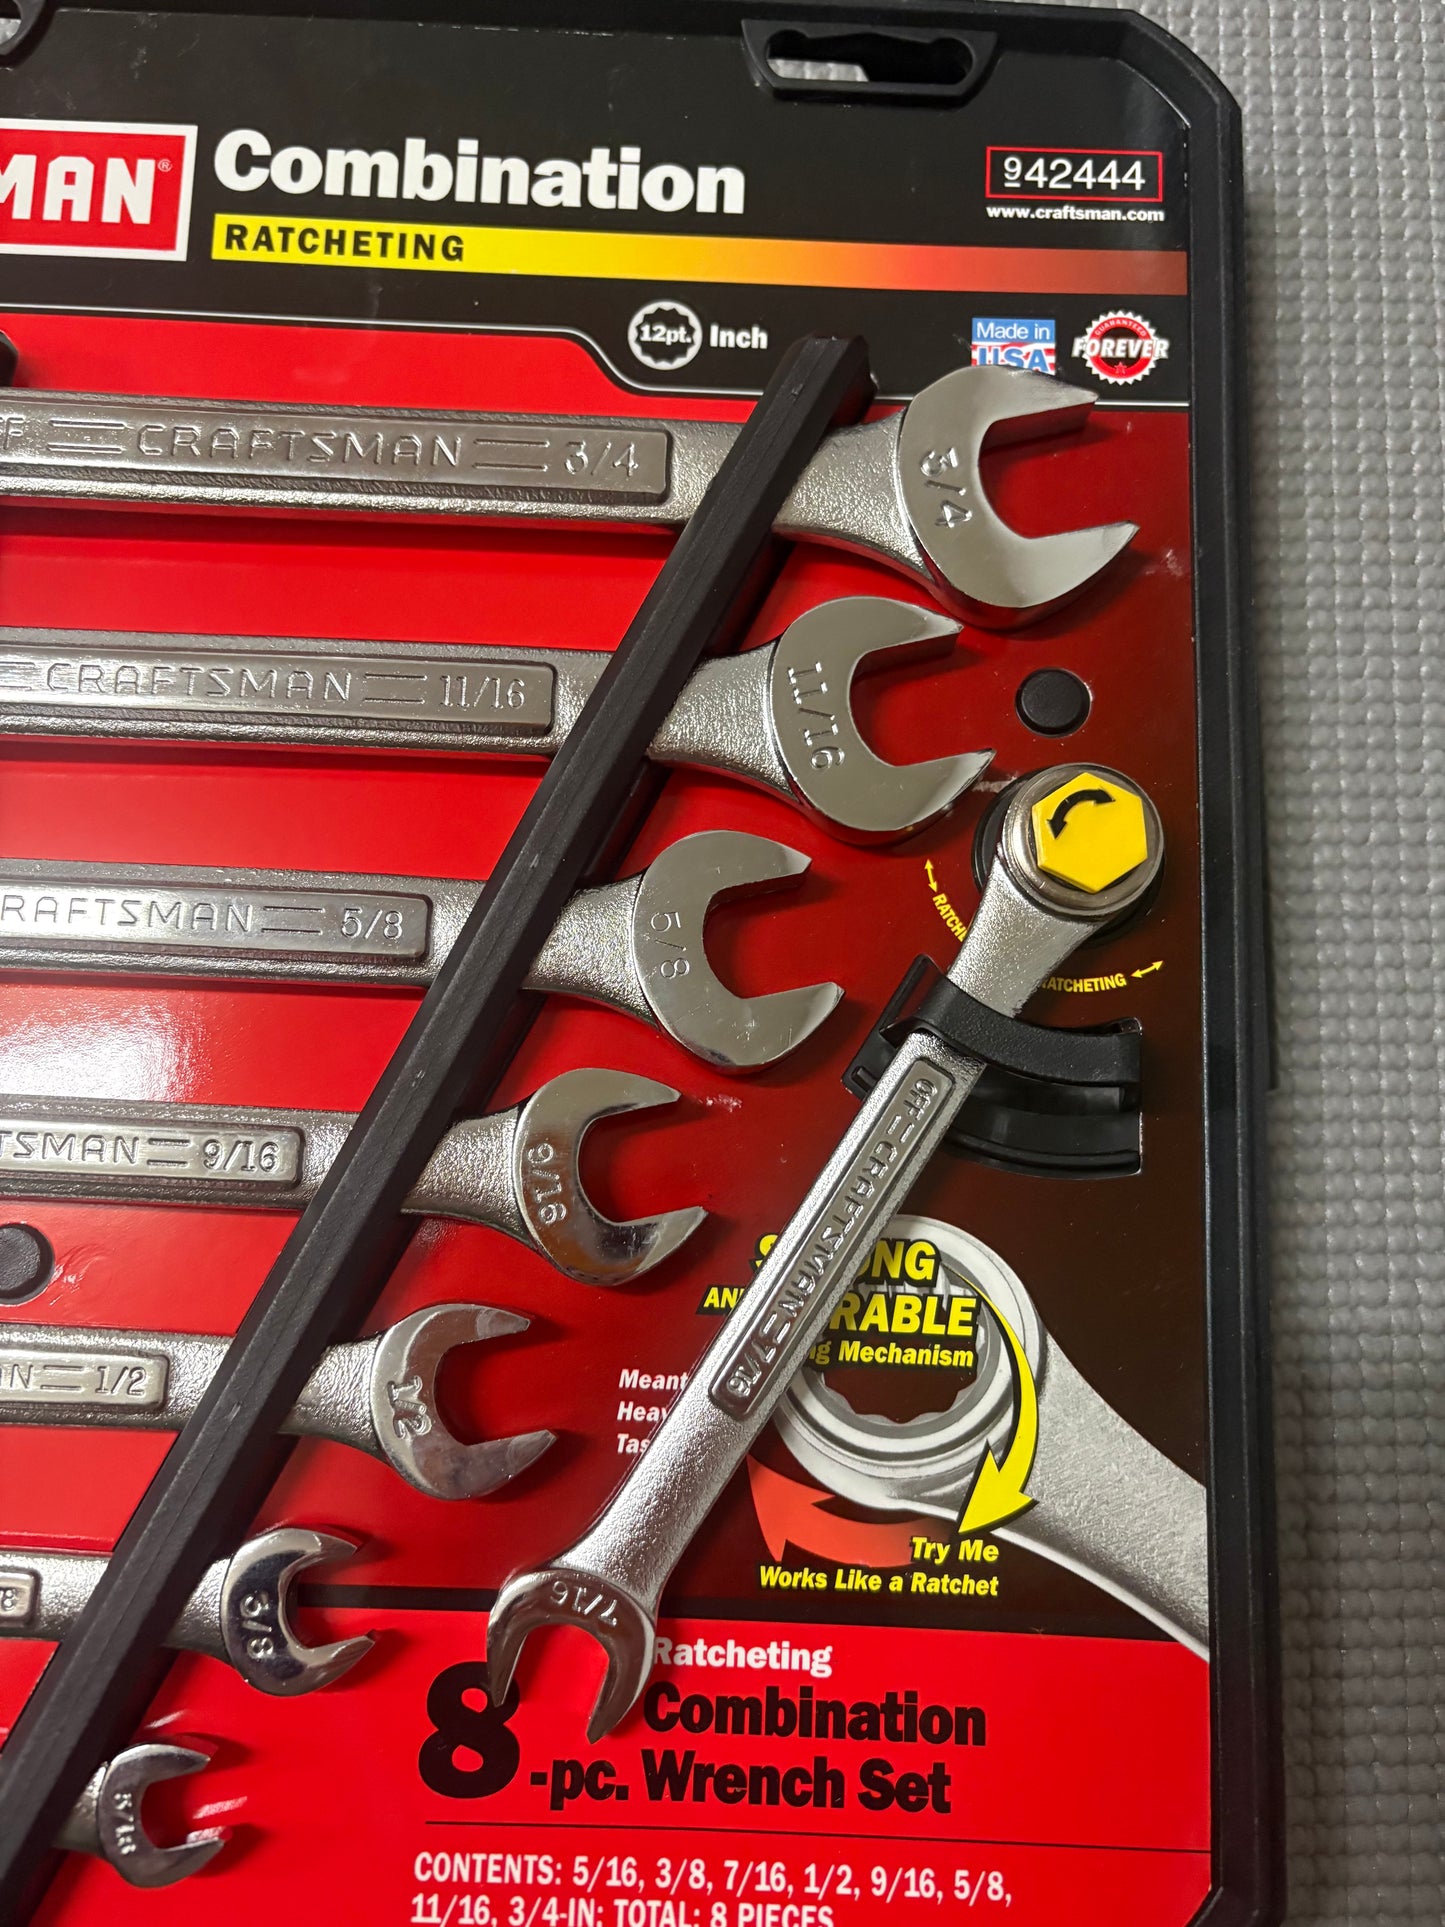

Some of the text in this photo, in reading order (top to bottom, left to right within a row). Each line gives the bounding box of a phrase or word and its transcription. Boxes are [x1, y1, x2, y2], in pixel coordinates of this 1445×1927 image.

[214, 129, 746, 214] Combination
[1003, 156, 1146, 190] 942444
[986, 205, 1165, 222] www.craftsman.com
[224, 223, 465, 262] RATCHETING
[639, 324, 769, 349] 12pt. Inch
[976, 321, 1051, 341] Made in
[1070, 337, 1171, 359] FOREVER
[1094, 319, 1148, 338] GUARANTEED
[978, 347, 1050, 373] USA
[138, 423, 462, 467] CRAFTSMAN
[563, 440, 640, 478] 3/4
[920, 446, 973, 529] 3/4
[46, 662, 526, 710] CRAFTSMAN 11/16
[787, 661, 846, 771] 11/16
[0, 894, 404, 941] RAFTSMAN 5/8
[650, 911, 691, 981] 5/8
[202, 1138, 281, 1173] 9/16
[527, 1142, 568, 1226] 9/16
[778, 1141, 898, 1318] CRAFTSMAN
[727, 1341, 777, 1398] 7/16
[838, 1340, 974, 1367] Mechanism
[95, 1366, 148, 1397] 1/2
[618, 1368, 689, 1391] Meant
[387, 1375, 432, 1439] 1/2
[616, 1400, 670, 1422] Heav
[911, 1536, 1000, 1565] Try Me
[759, 1565, 1000, 1596] Works Like a Ratchet
[240, 1588, 275, 1660] 3/8
[550, 1580, 618, 1627] 7/16
[653, 1636, 833, 1677] Ratcheting
[643, 1681, 987, 1747] Combination
[641, 1748, 846, 1809] Wrench
[856, 1757, 952, 1815] Set
[414, 1851, 1013, 1908] CONTENTS: 5/16, 3/8, 7/16, 1/2, 9/16, 5/8,
[410, 1893, 498, 1927] 11/16,
[613, 1899, 701, 1927] TOTAL:
[738, 1903, 834, 1927] PIECES
